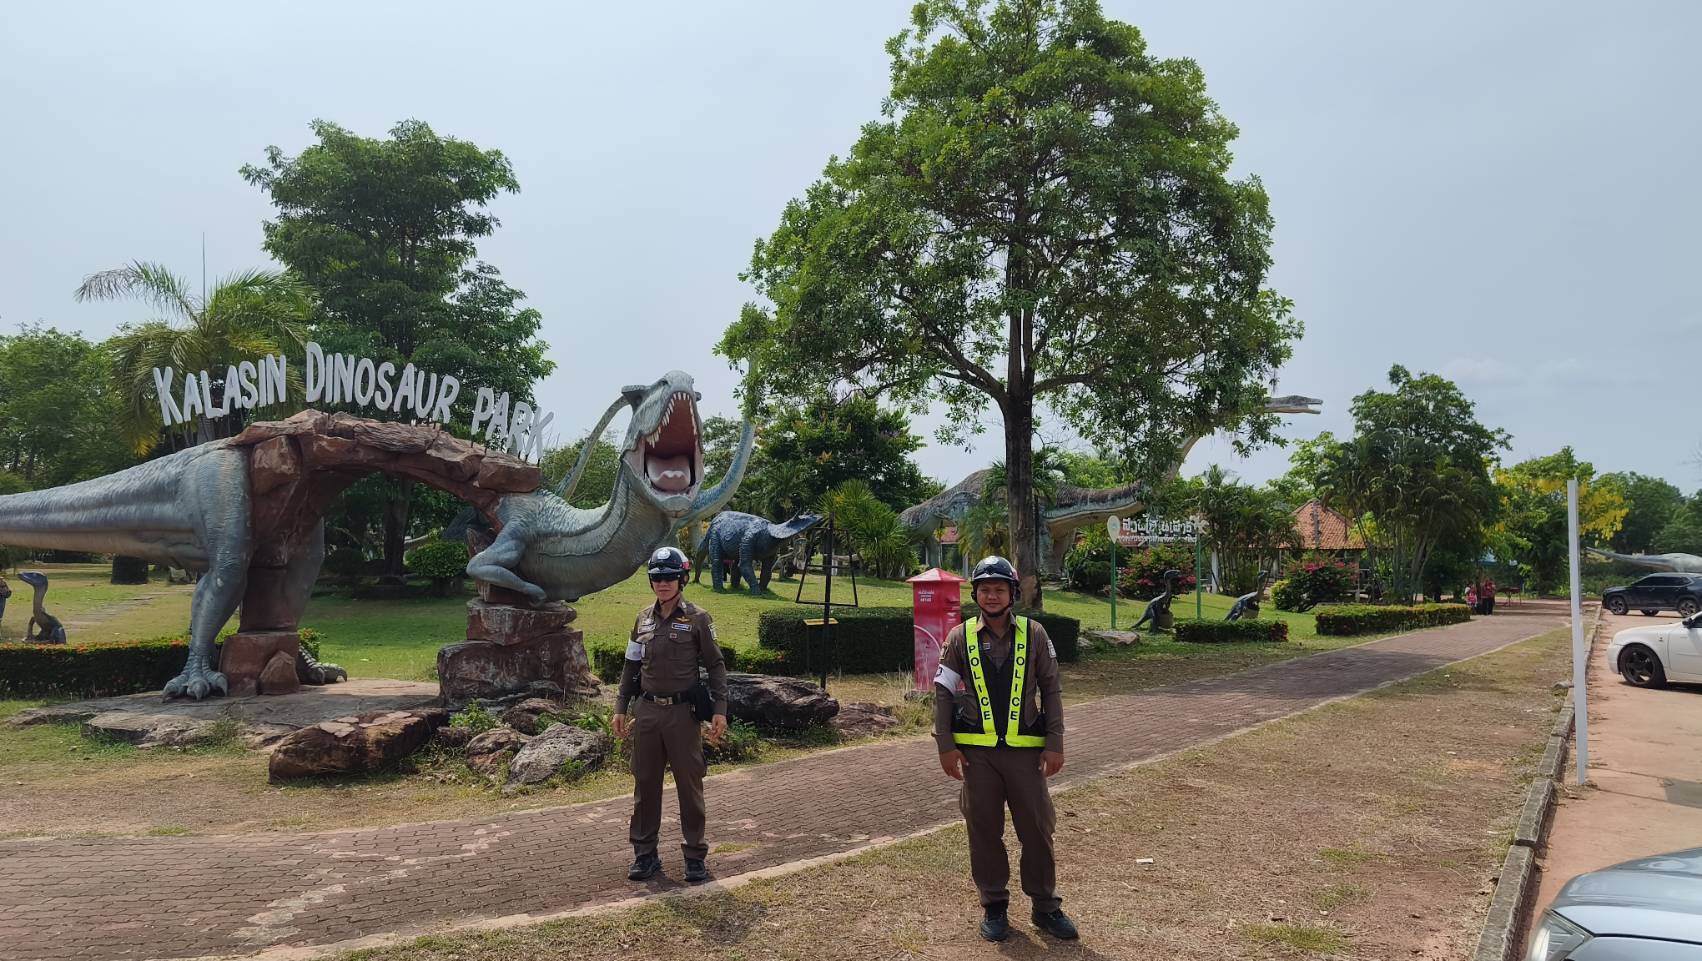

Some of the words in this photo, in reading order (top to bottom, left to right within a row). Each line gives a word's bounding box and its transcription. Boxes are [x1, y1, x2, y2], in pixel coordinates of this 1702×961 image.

[153, 354, 286, 426] KALASIN
[306, 342, 460, 424] DINOSAUR
[471, 387, 555, 460] PARK
[968, 645, 992, 721] POLICE
[1010, 643, 1026, 721] POLICE
